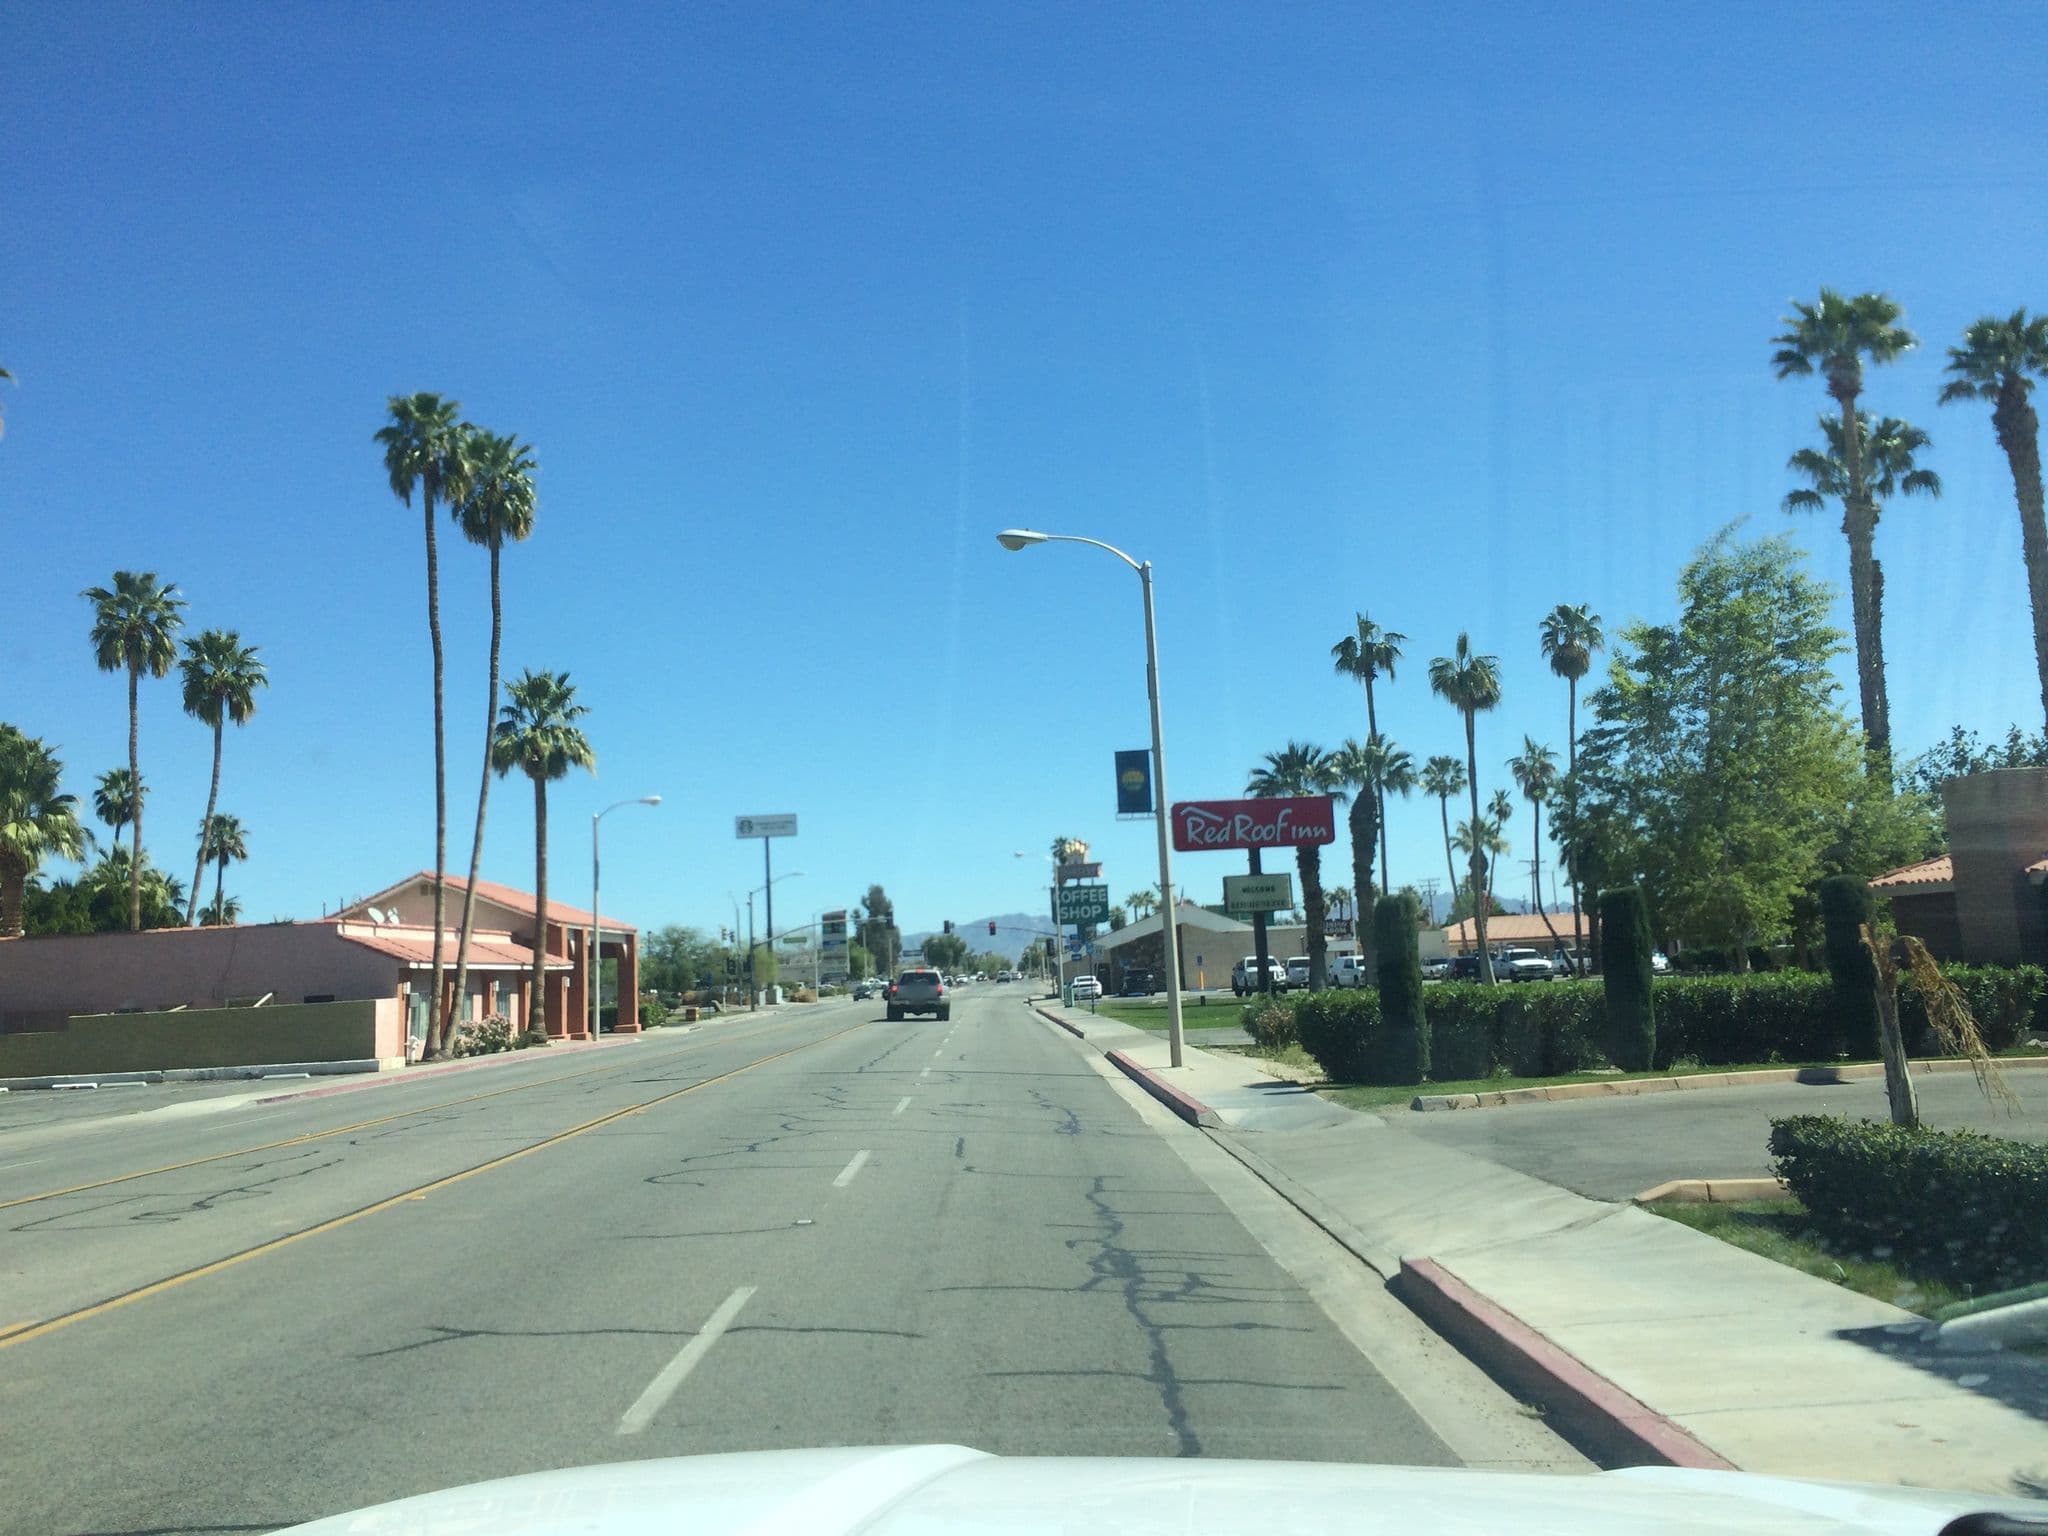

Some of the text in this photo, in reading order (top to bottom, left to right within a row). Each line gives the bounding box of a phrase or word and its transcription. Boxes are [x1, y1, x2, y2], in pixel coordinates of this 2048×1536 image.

[1186, 815, 1231, 844] Red
[1234, 808, 1292, 842] Roof
[1059, 904, 1102, 920] SHOP
